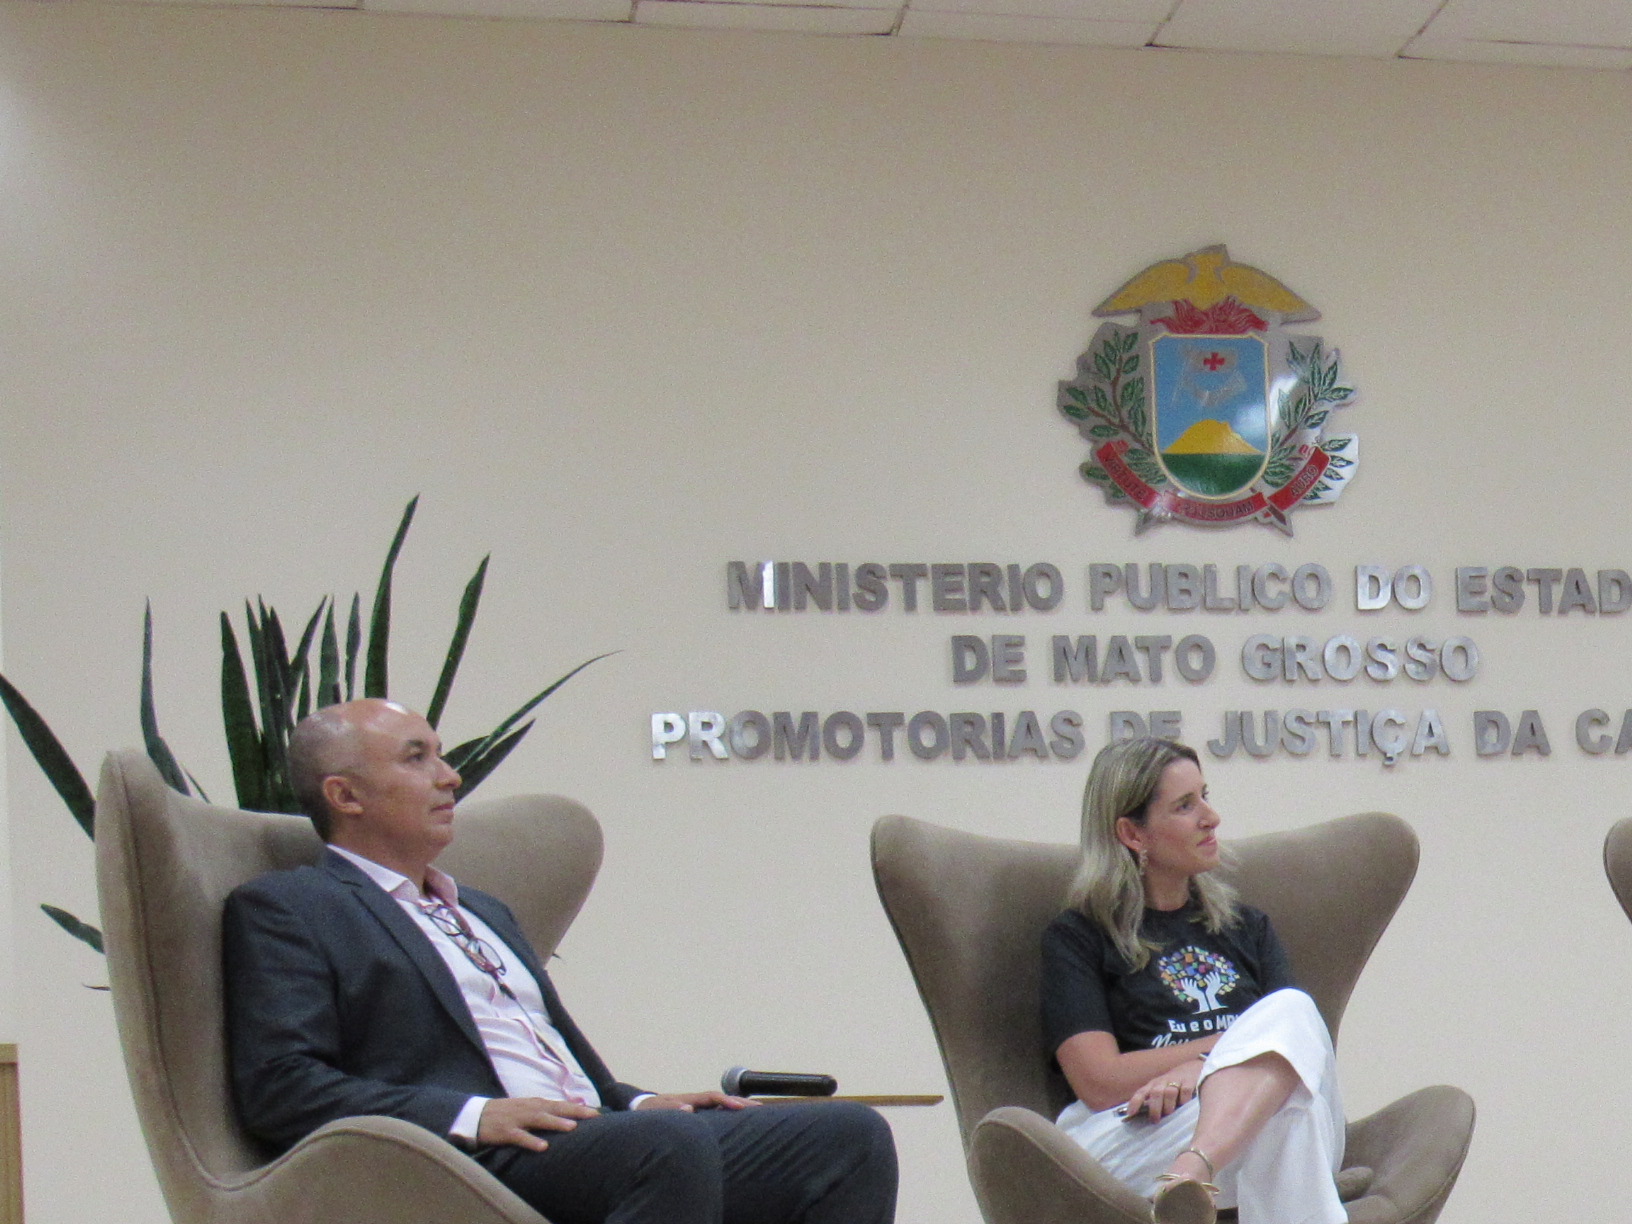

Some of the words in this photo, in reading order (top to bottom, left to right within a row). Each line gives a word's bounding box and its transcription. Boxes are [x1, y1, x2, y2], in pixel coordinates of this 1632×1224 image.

[727, 560, 1064, 612] MINISTERIO
[1089, 562, 1332, 612] PUBLICO
[1354, 563, 1433, 611] DO
[951, 634, 1026, 683] DE
[1053, 634, 1216, 683] MATO
[1241, 634, 1479, 682] GROSSO
[651, 709, 1086, 761] PROMOTORIAS
[1207, 709, 1450, 767] JUSTIÇA
[1474, 709, 1552, 757] DA
[1168, 1019, 1187, 1033] Eu
[1189, 1020, 1200, 1032] e
[1203, 1019, 1214, 1031] o
